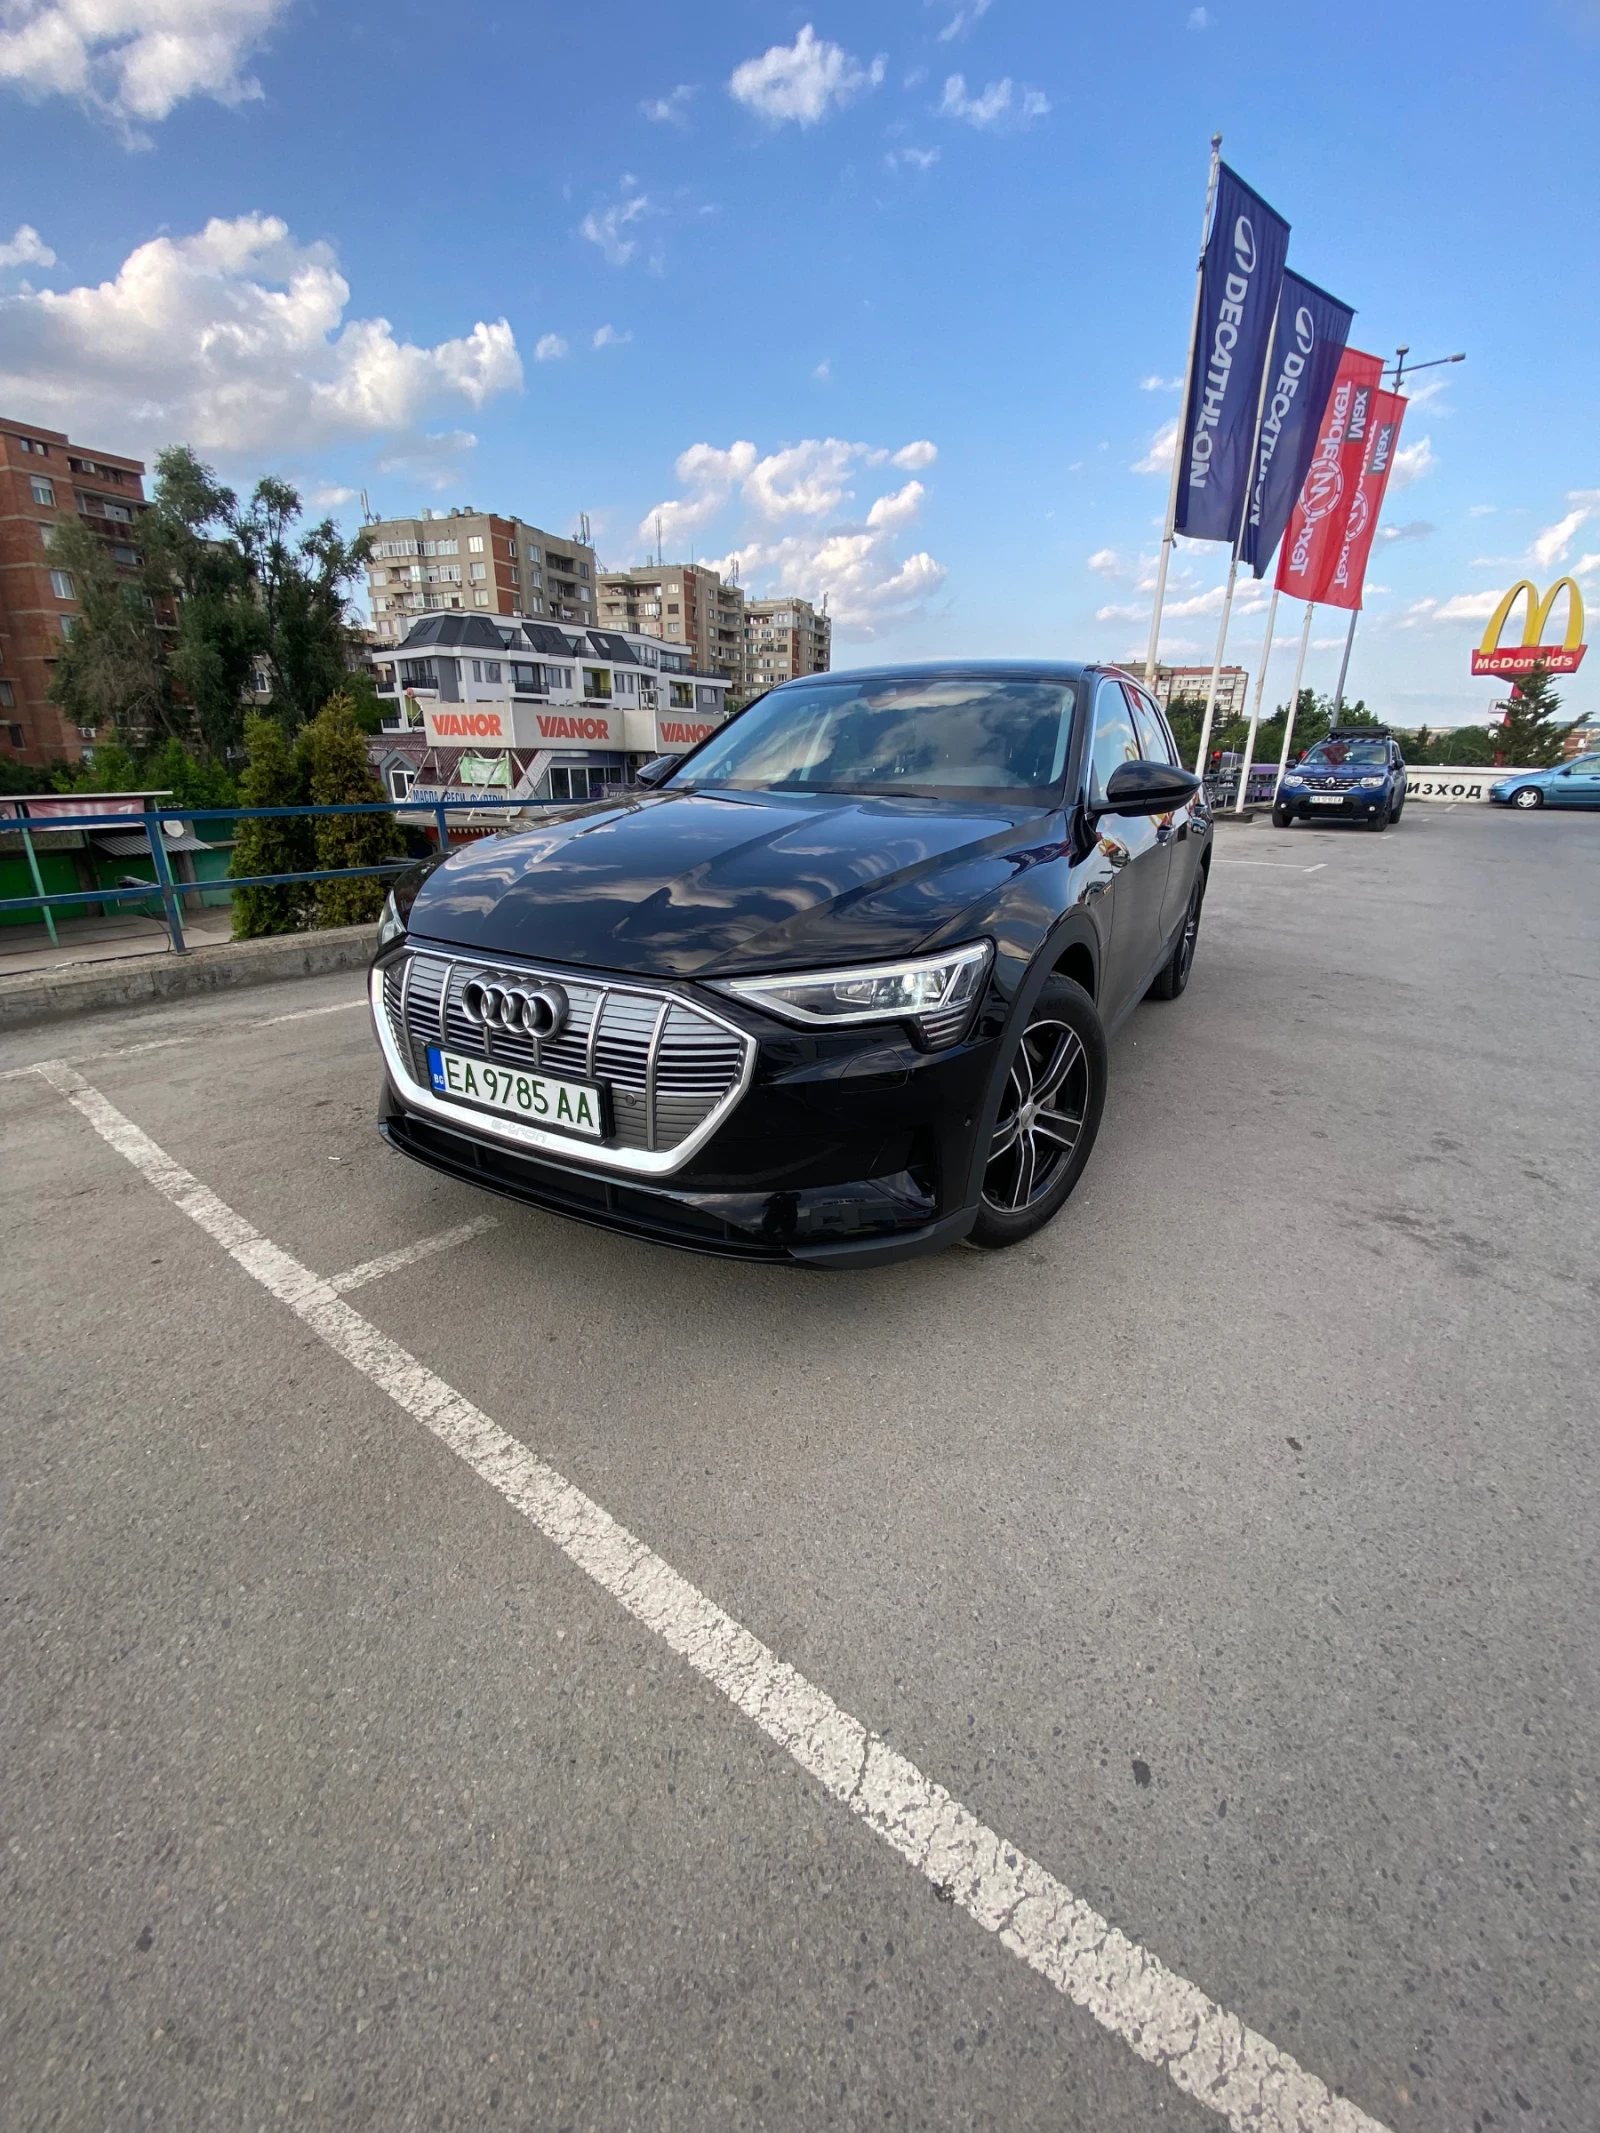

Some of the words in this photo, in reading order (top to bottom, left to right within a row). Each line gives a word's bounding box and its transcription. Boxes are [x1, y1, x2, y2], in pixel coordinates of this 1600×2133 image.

[1189, 272, 1248, 488] DECATHLON
[1248, 351, 1305, 527] DECATHN
[432, 714, 502, 736] VIANOR
[536, 715, 610, 740] VIANOR
[1405, 782, 1482, 799] ИЗХОД
[433, 1074, 444, 1085] BG
[445, 1057, 479, 1096] EA
[483, 1068, 549, 1114] 9785
[557, 1087, 594, 1127] AA
[491, 1119, 547, 1143] e-tron
